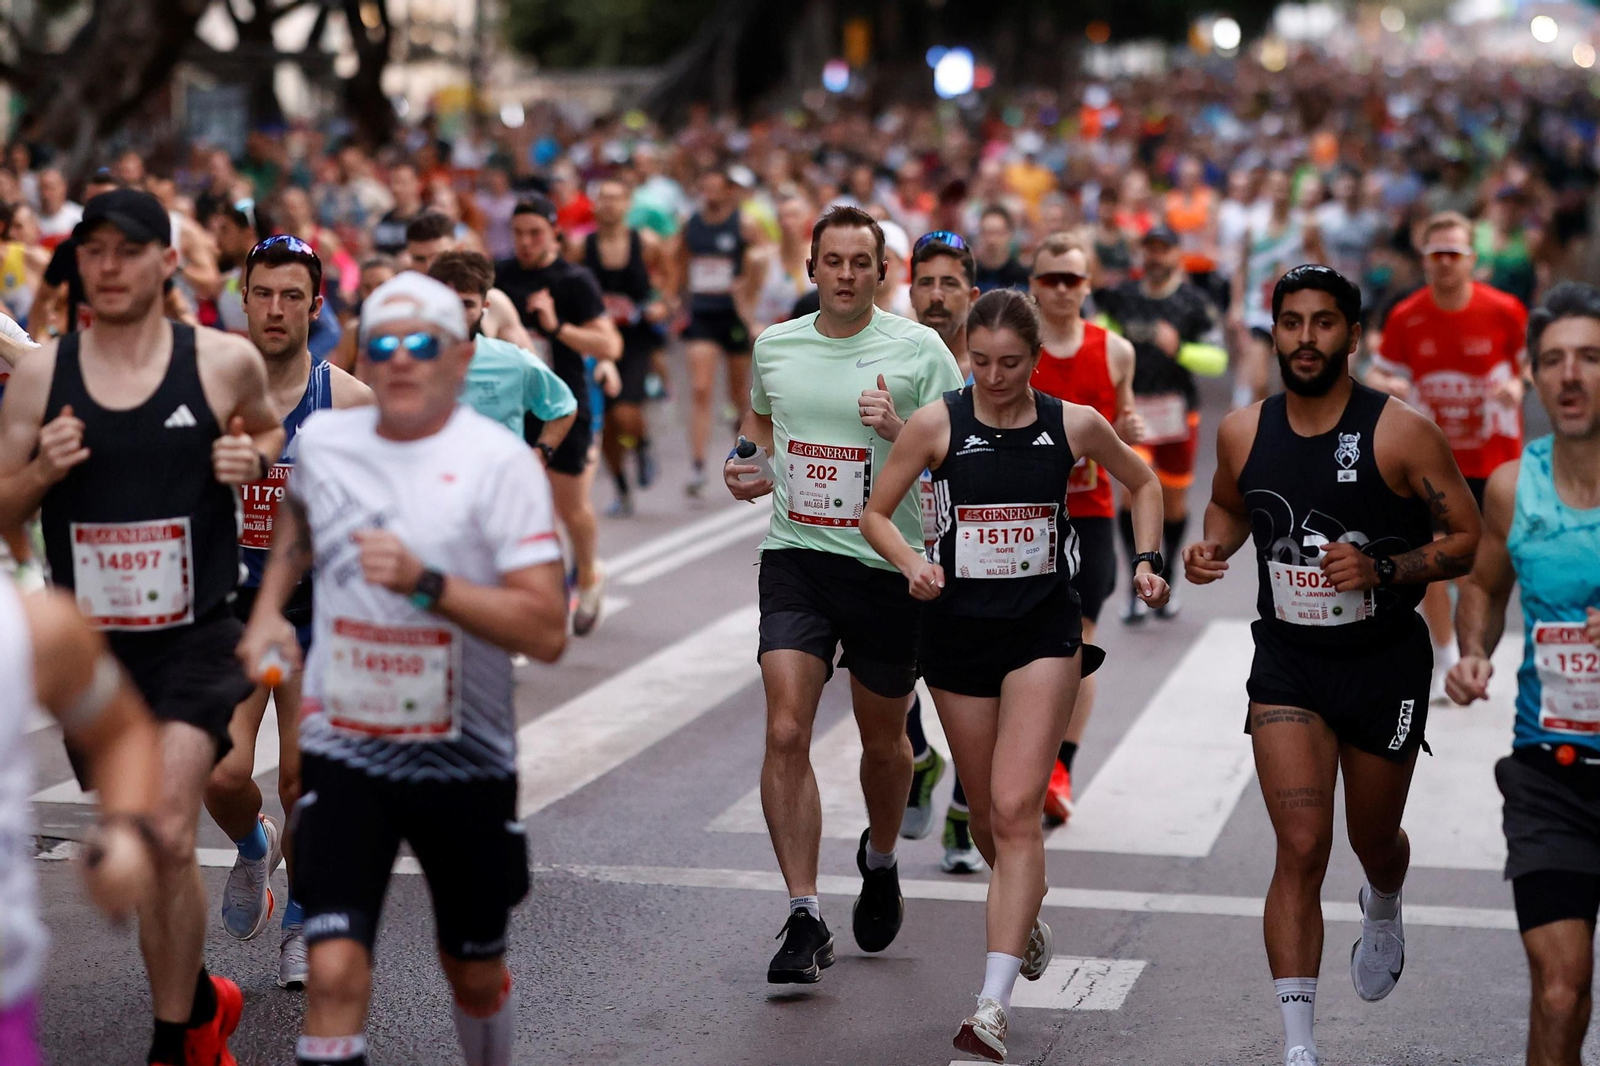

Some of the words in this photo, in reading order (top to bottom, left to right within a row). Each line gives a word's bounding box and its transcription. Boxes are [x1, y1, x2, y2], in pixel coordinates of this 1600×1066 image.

[804, 444, 859, 460] GENERALI
[806, 463, 838, 482] 202
[241, 484, 286, 502] 1179
[253, 503, 271, 511] LARS
[982, 507, 1042, 521] GENERALI
[977, 526, 1034, 545] 15170
[97, 550, 162, 571] 14897
[1286, 570, 1335, 589] 1502
